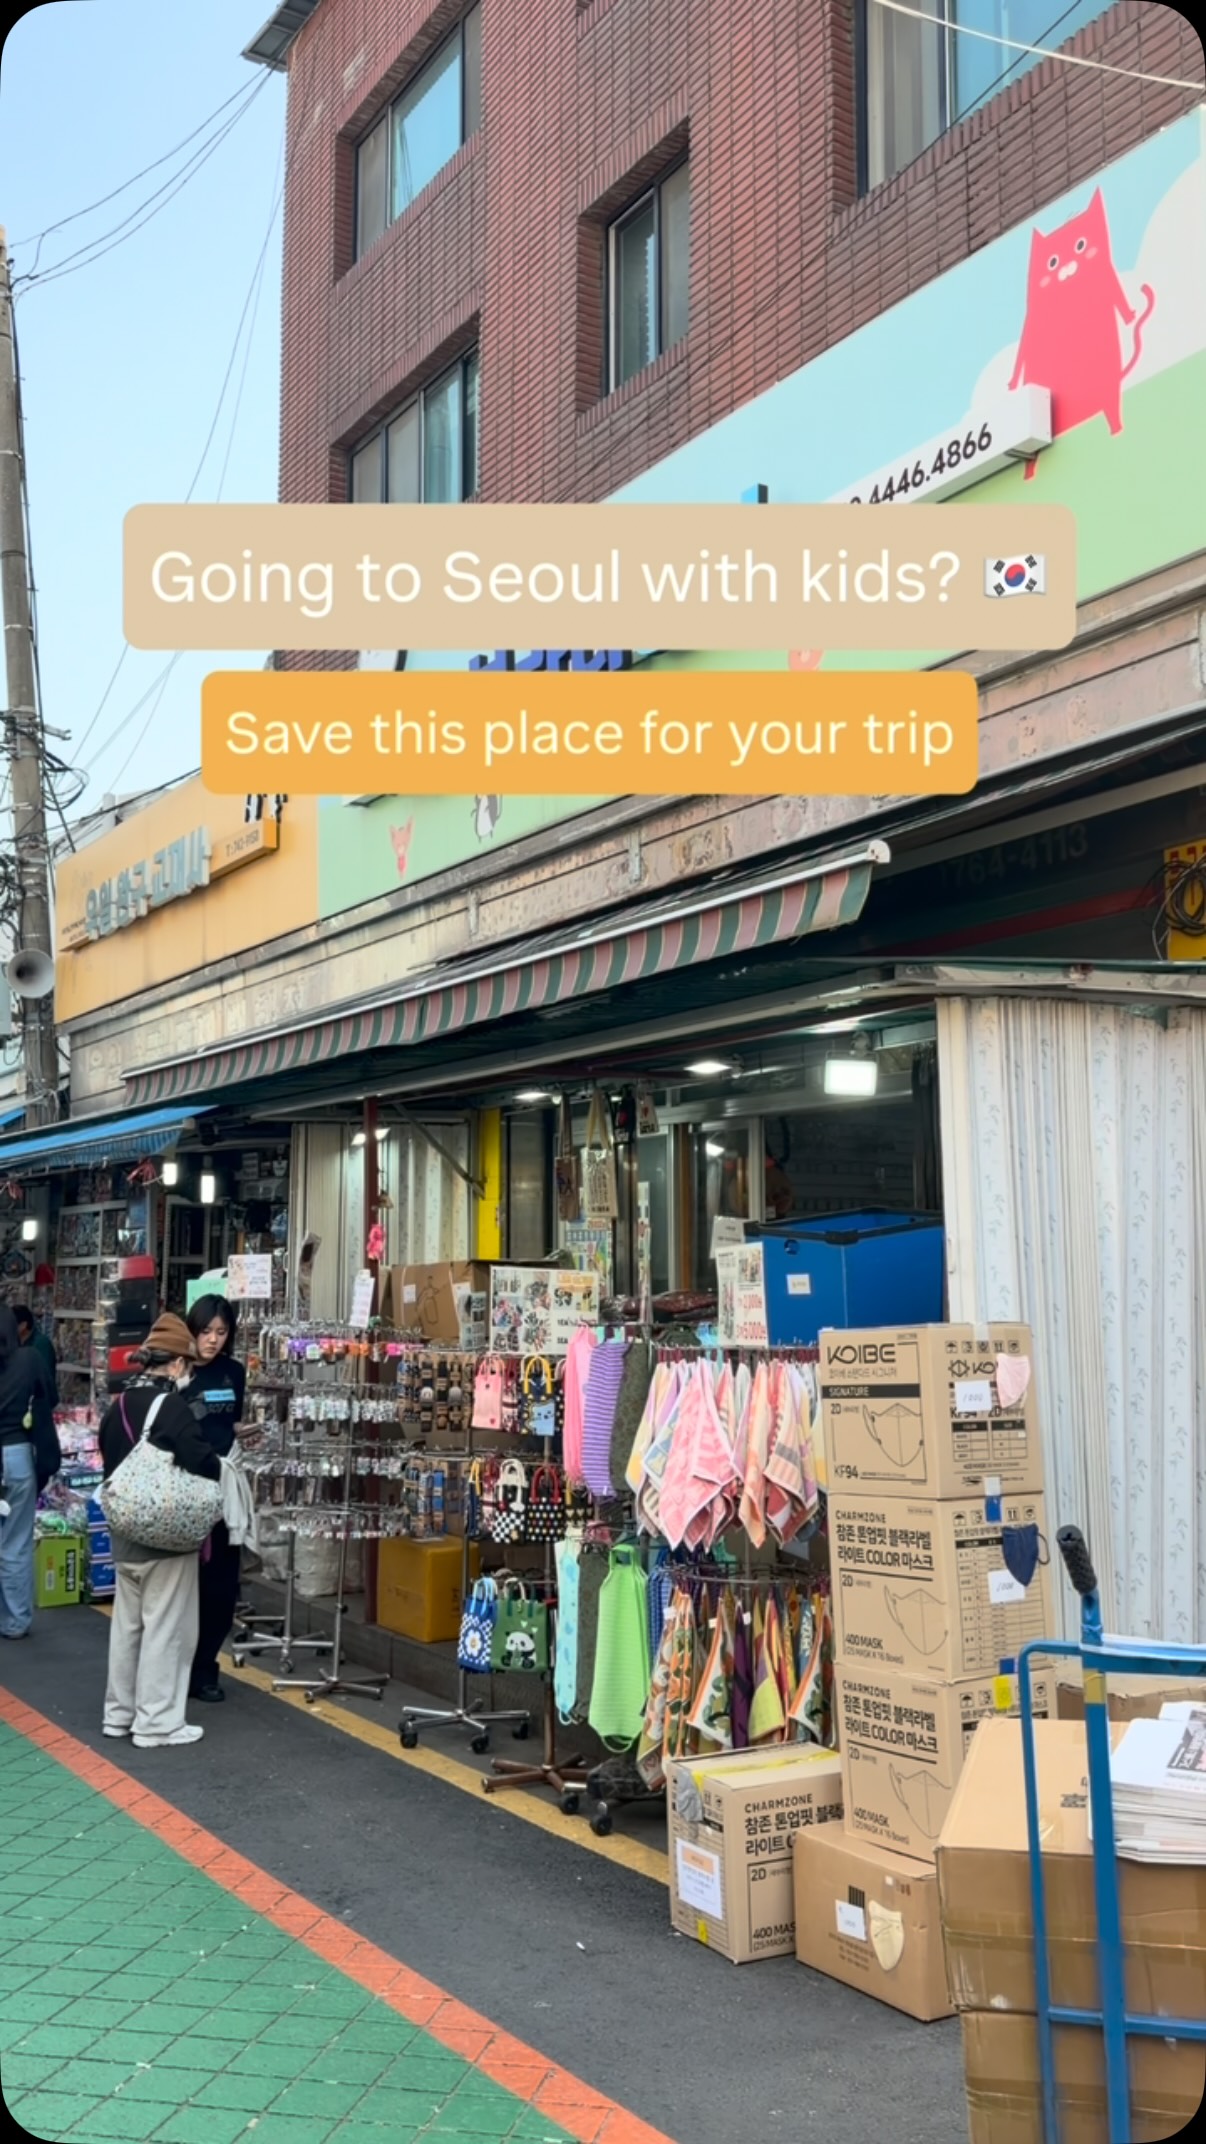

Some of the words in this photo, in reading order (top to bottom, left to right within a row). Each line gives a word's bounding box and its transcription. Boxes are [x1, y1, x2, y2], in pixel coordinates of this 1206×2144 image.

[827, 1343, 896, 1365] KOIBE
[829, 1387, 870, 1397] SIGNATURE
[834, 1465, 858, 1479] KF94
[835, 1510, 886, 1523] CHARMZONE
[836, 1524, 855, 1542] 참존
[888, 1528, 932, 1551] 블랙라벨
[837, 1545, 866, 1564] 라이트
[866, 1549, 901, 1567] COLOR
[901, 1552, 935, 1571] 마스크
[860, 1635, 883, 1650] MASK
[842, 1680, 890, 1699] CHARMZONE
[843, 1694, 861, 1715] 참존
[845, 1716, 871, 1738] 라이트
[871, 1724, 906, 1746] COLOR
[906, 1731, 939, 1754] 마스크
[745, 1793, 813, 1813] CHARMZONE
[745, 1814, 771, 1836] 참존
[775, 1807, 813, 1831] 톤업핏
[746, 1836, 785, 1856] 라이트
[751, 1867, 766, 1881] 2D
[753, 1926, 772, 1939] 400
[774, 1921, 796, 1936] MAS
